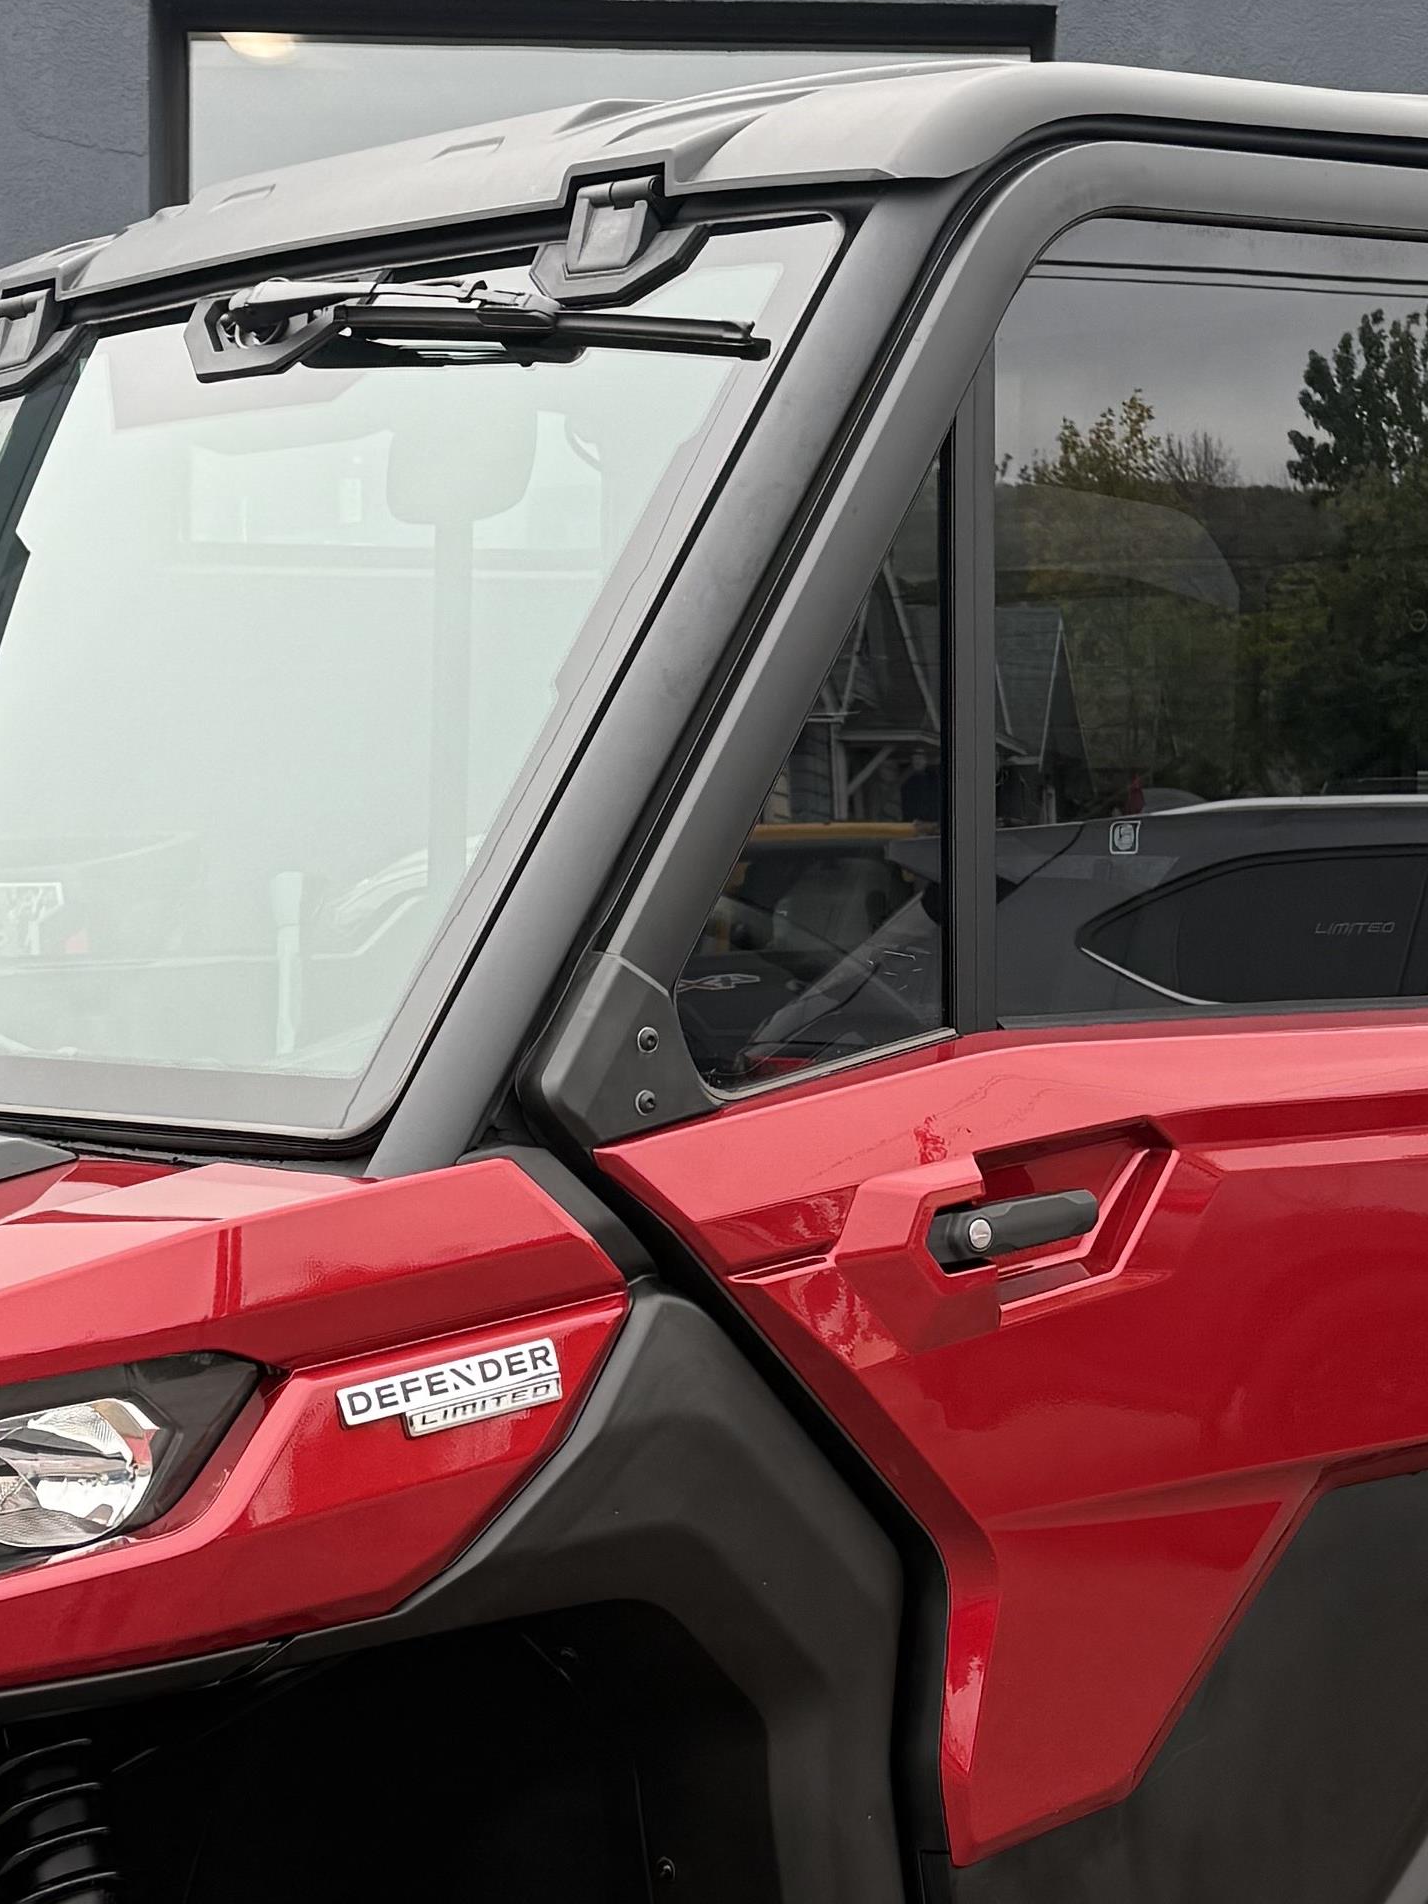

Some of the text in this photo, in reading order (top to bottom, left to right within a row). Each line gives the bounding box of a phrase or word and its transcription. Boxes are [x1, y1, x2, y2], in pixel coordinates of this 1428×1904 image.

[1314, 921, 1397, 937] LIMITED
[347, 1345, 553, 1416] DEFENDER
[421, 1383, 551, 1426] LIMITED
